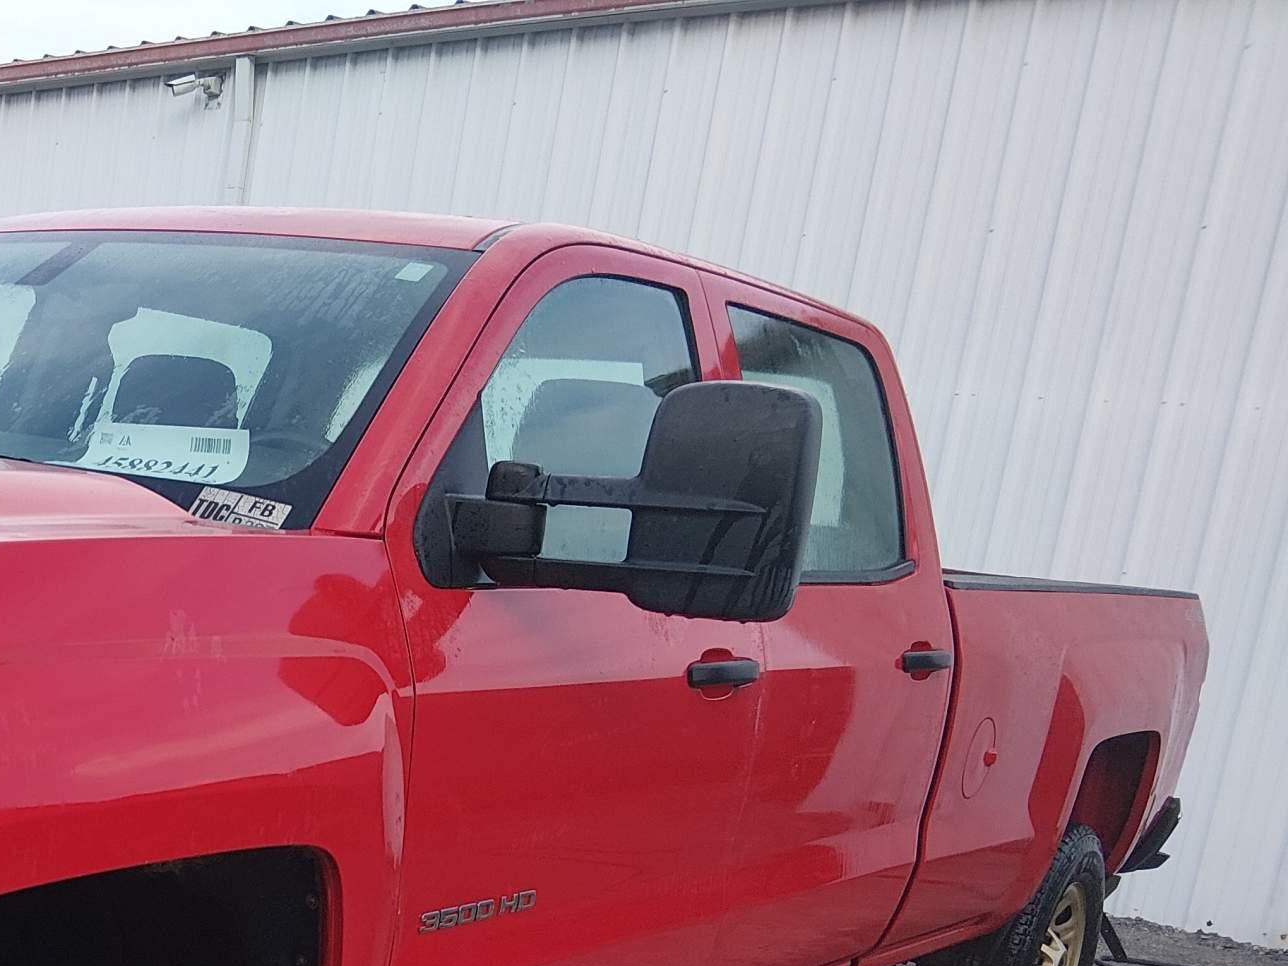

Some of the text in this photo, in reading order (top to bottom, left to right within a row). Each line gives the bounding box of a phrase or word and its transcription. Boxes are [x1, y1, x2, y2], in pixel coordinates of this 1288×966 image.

[192, 498, 231, 521] TDC
[248, 501, 276, 518] FB
[418, 889, 536, 933] 3500 HD
